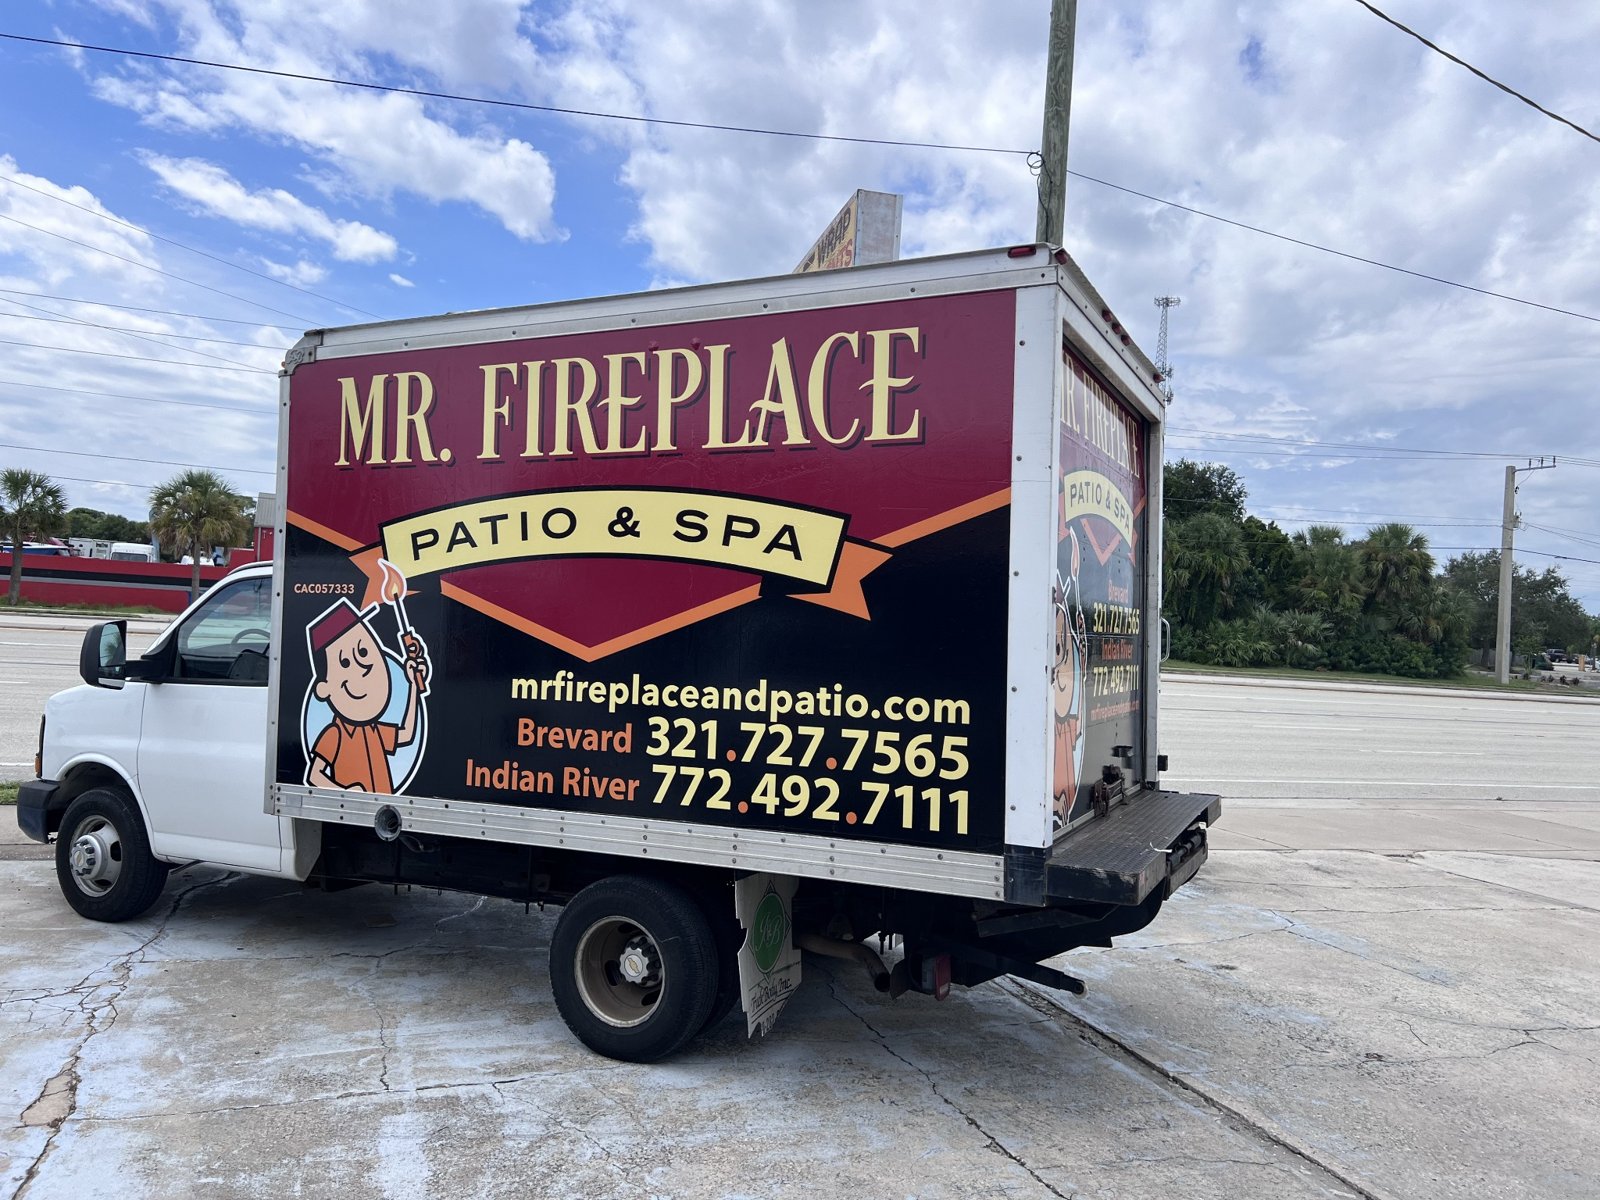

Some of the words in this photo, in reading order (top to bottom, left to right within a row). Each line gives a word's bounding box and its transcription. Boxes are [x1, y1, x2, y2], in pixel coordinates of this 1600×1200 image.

[335, 371, 453, 467] MR.
[476, 326, 923, 461] FIREPLACE
[1082, 370, 1140, 479] FIREPLACE
[410, 507, 577, 561] PATIO
[607, 506, 641, 538] &
[672, 509, 803, 561] SPA
[1069, 481, 1102, 508] PATIO
[1105, 492, 1111, 510] &
[1113, 500, 1131, 535] SPA
[293, 582, 355, 595] CAC057333
[1108, 579, 1129, 603] Brevard
[1093, 602, 1140, 635] 321.727.7565
[1101, 637, 1120, 661] Indian
[511, 670, 970, 725] mrfireplaceandpatio.com
[1093, 665, 1139, 697] 772.492.7111
[517, 718, 632, 753] Brevard
[645, 716, 969, 780] 321.727.7565
[466, 759, 554, 793] Indian
[563, 767, 640, 801] River
[652, 764, 969, 835] 772.492.7111
